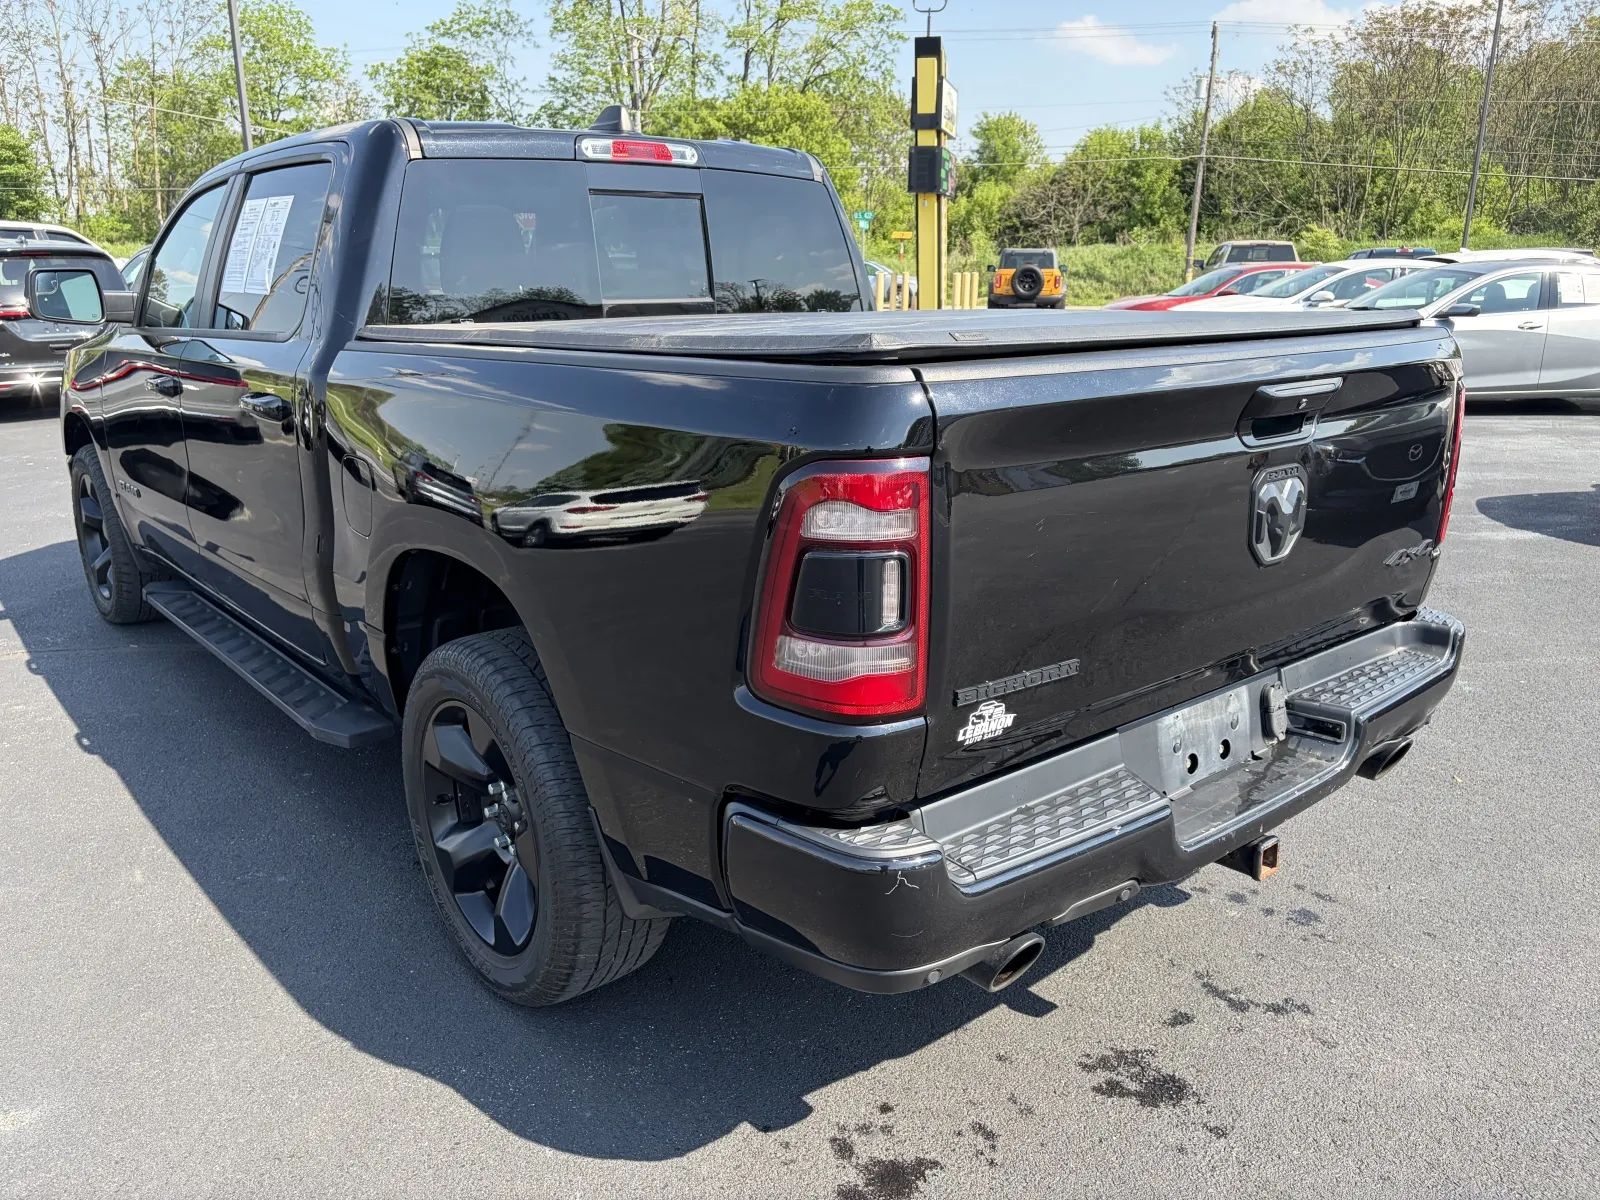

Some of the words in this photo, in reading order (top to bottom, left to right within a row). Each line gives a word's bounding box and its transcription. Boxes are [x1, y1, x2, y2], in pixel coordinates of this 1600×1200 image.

[1267, 466, 1299, 481] RAM
[957, 713, 1017, 742] LEBANON
[963, 736, 983, 746] AUTO
[983, 729, 1004, 740] SALES
